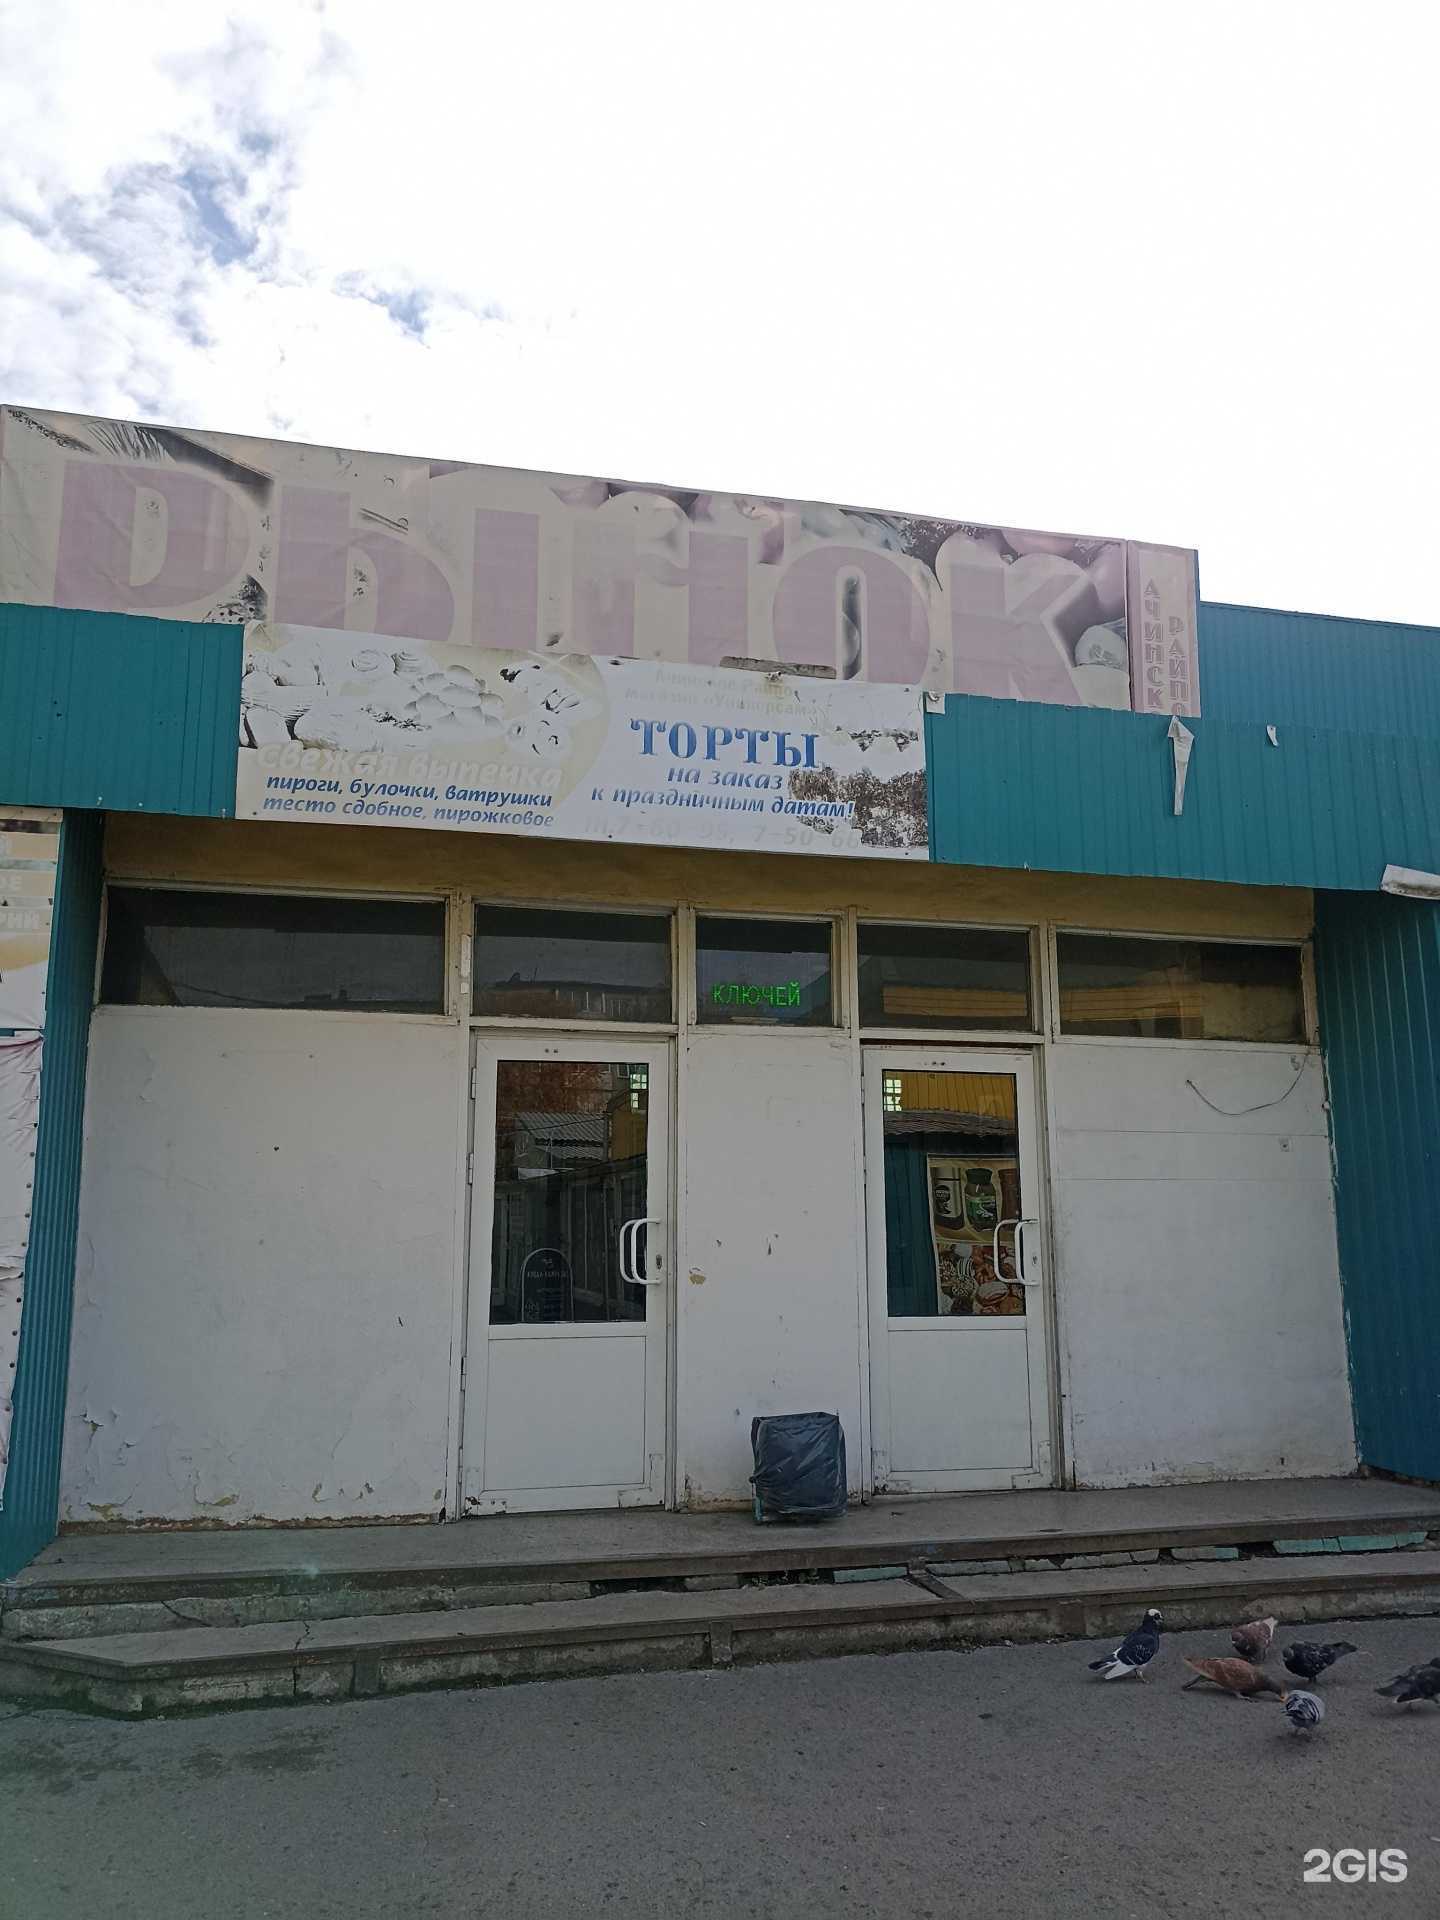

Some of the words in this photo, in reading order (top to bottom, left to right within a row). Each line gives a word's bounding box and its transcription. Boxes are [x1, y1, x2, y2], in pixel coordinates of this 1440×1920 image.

[630, 718, 819, 769] ТОРТЫ
[266, 775, 342, 795] пироги,
[350, 778, 438, 800] булочки,
[445, 787, 552, 807] ватрушки
[667, 767, 701, 784] на
[708, 769, 783, 790] заказ
[263, 797, 336, 814] тесто
[342, 799, 426, 820] сдобное,
[433, 809, 554, 828] пирожковое
[591, 787, 603, 801] к
[613, 788, 764, 813] праздничным
[771, 796, 854, 818] датам!
[712, 981, 800, 1007] КЛЮЧЕЙ
